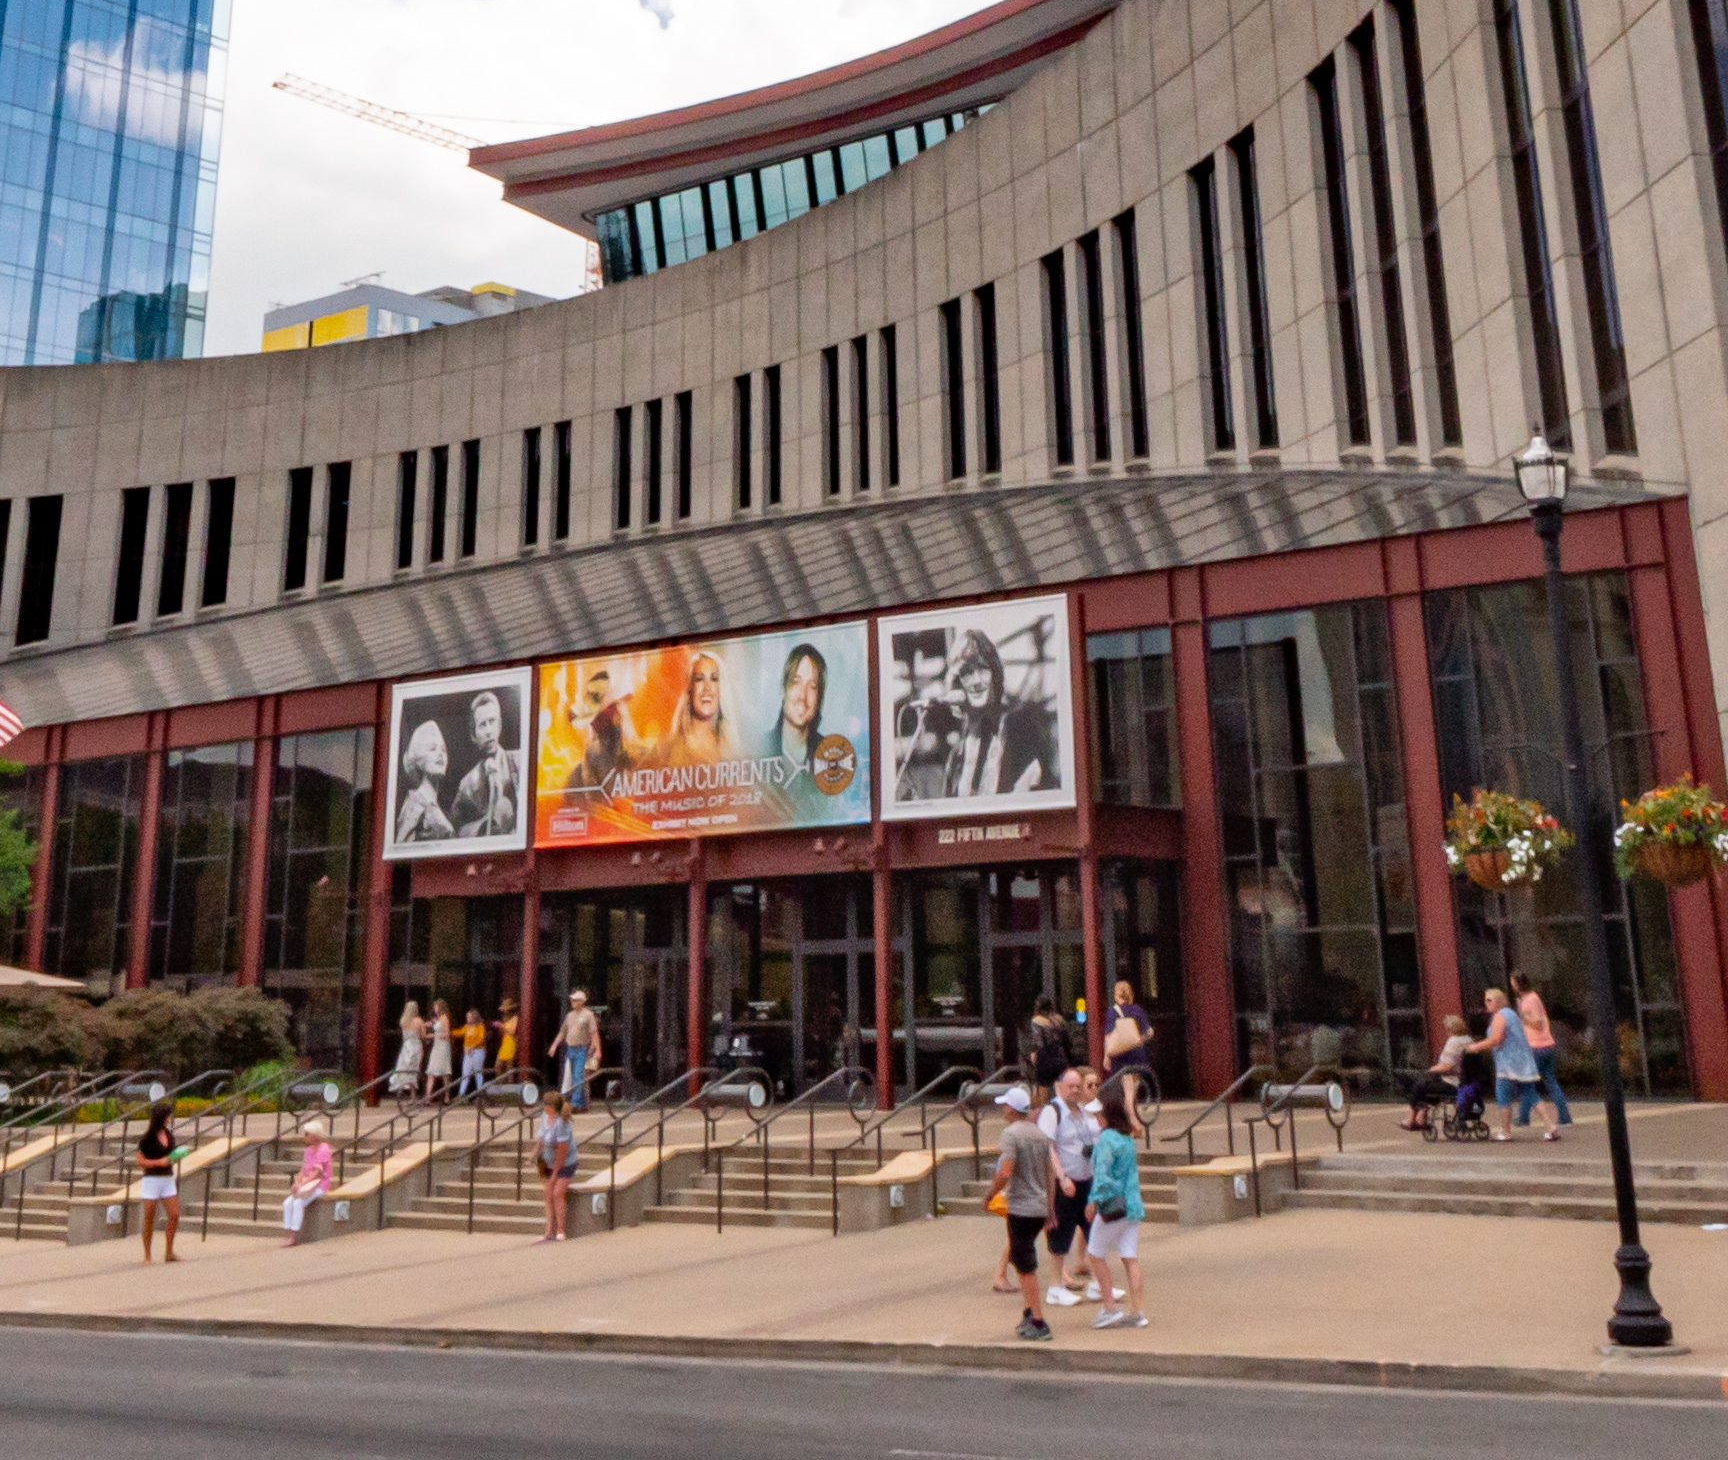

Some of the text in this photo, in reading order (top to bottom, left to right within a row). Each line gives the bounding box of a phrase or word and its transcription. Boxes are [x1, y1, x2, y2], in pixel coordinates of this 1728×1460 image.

[610, 755, 785, 798] AMERICAN CURRENTS
[632, 801, 657, 815] THE
[660, 797, 706, 813] MUSIC
[708, 795, 726, 808] OF
[551, 819, 584, 833] Hilton
[937, 828, 955, 845] 222
[956, 826, 984, 843] FIFTH
[985, 824, 1020, 841] AVENUE
